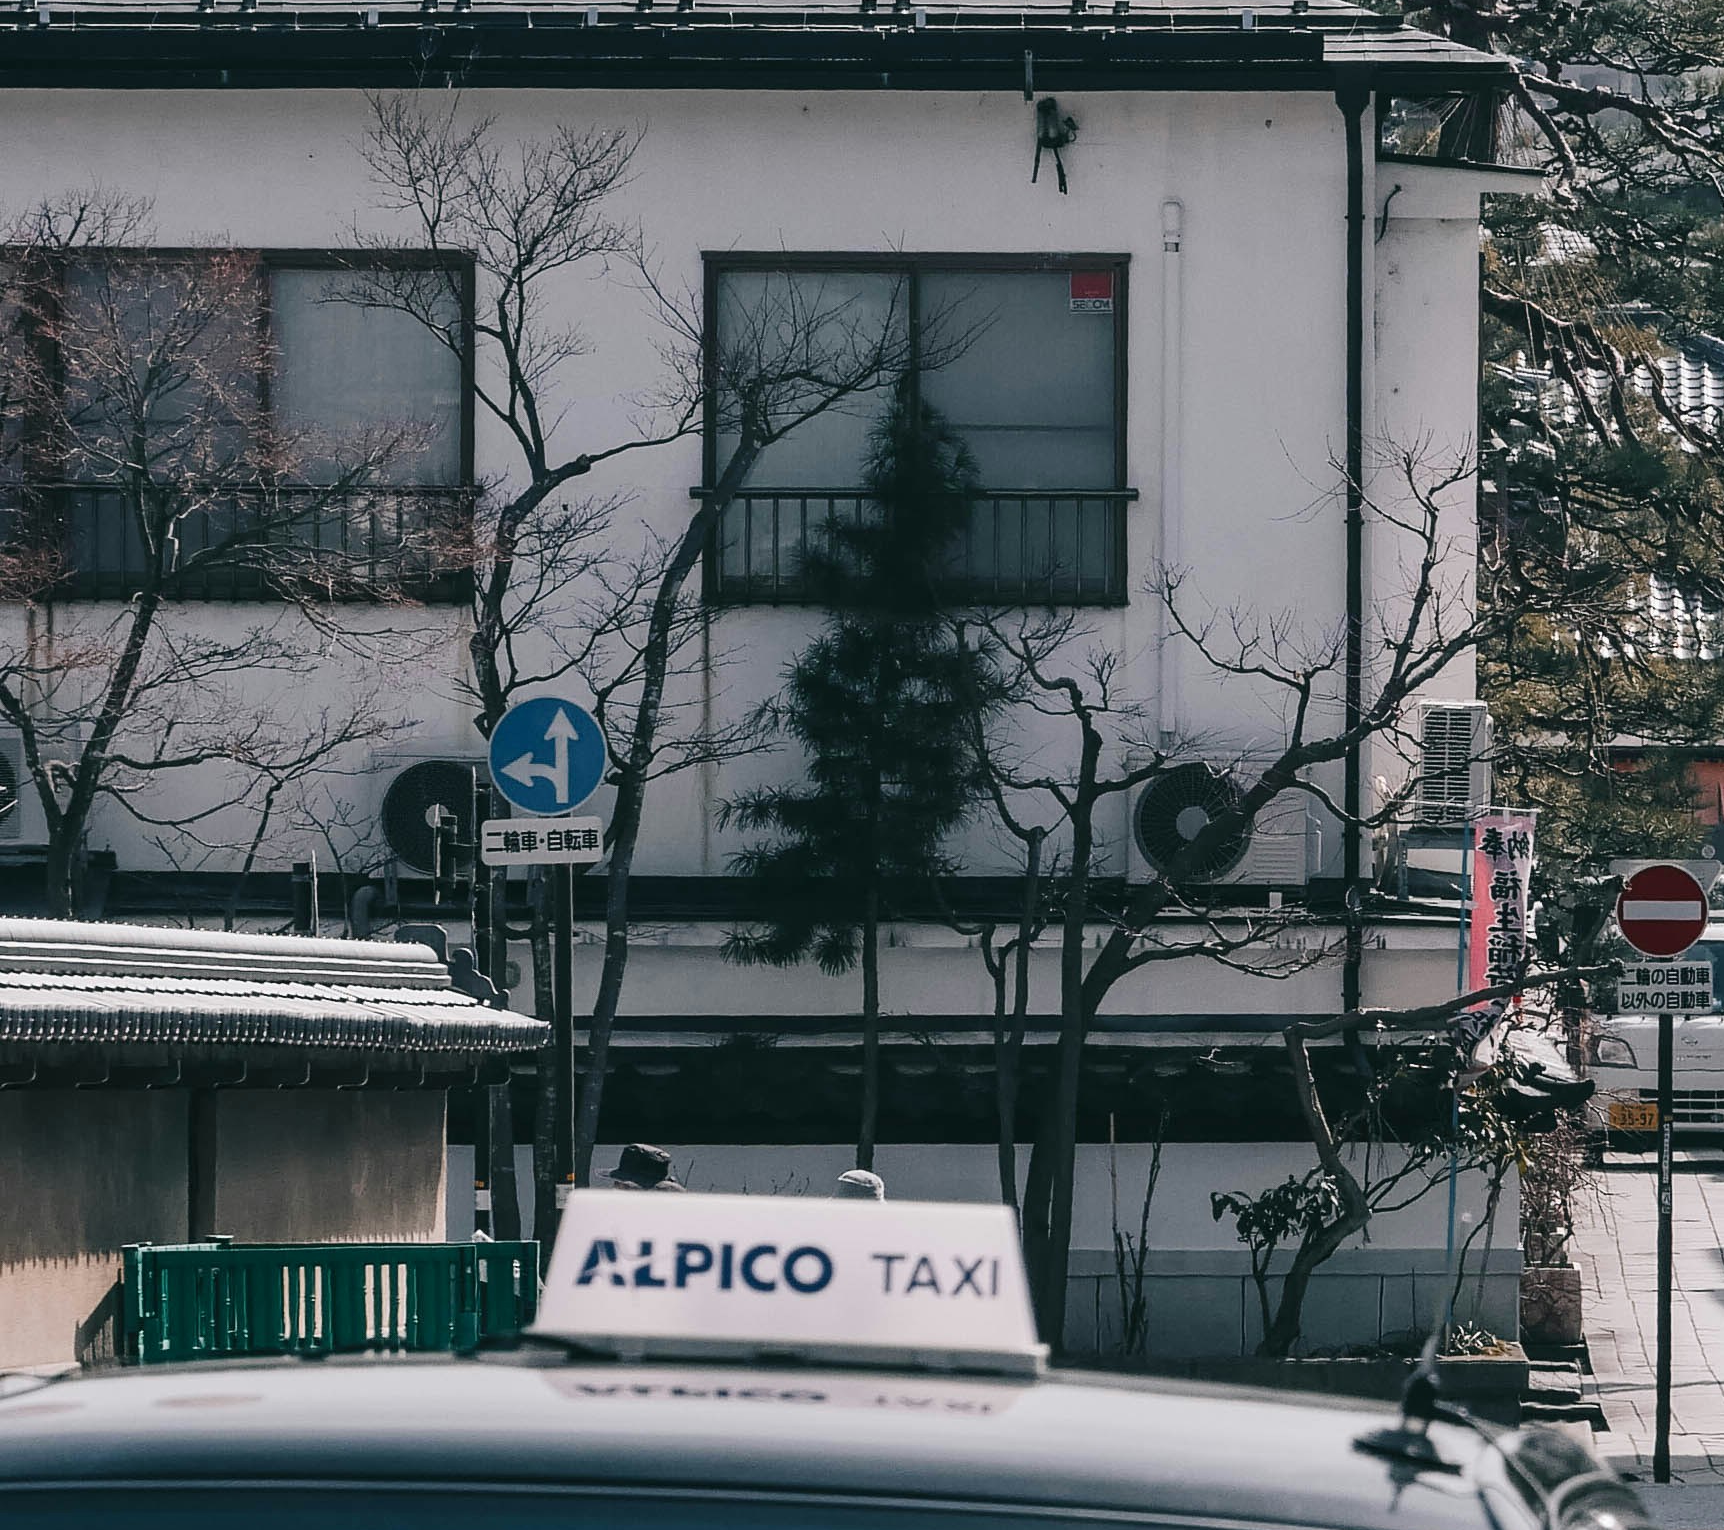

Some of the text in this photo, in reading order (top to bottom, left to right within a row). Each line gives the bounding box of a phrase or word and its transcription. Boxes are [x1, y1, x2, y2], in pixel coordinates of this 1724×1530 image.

[485, 828, 600, 854] 二輪車・自転車
[1620, 967, 1711, 986] 二輪の自動車
[1621, 992, 1711, 1010] 以外の自動車
[575, 1238, 1000, 1298] ALPICO TAXI
